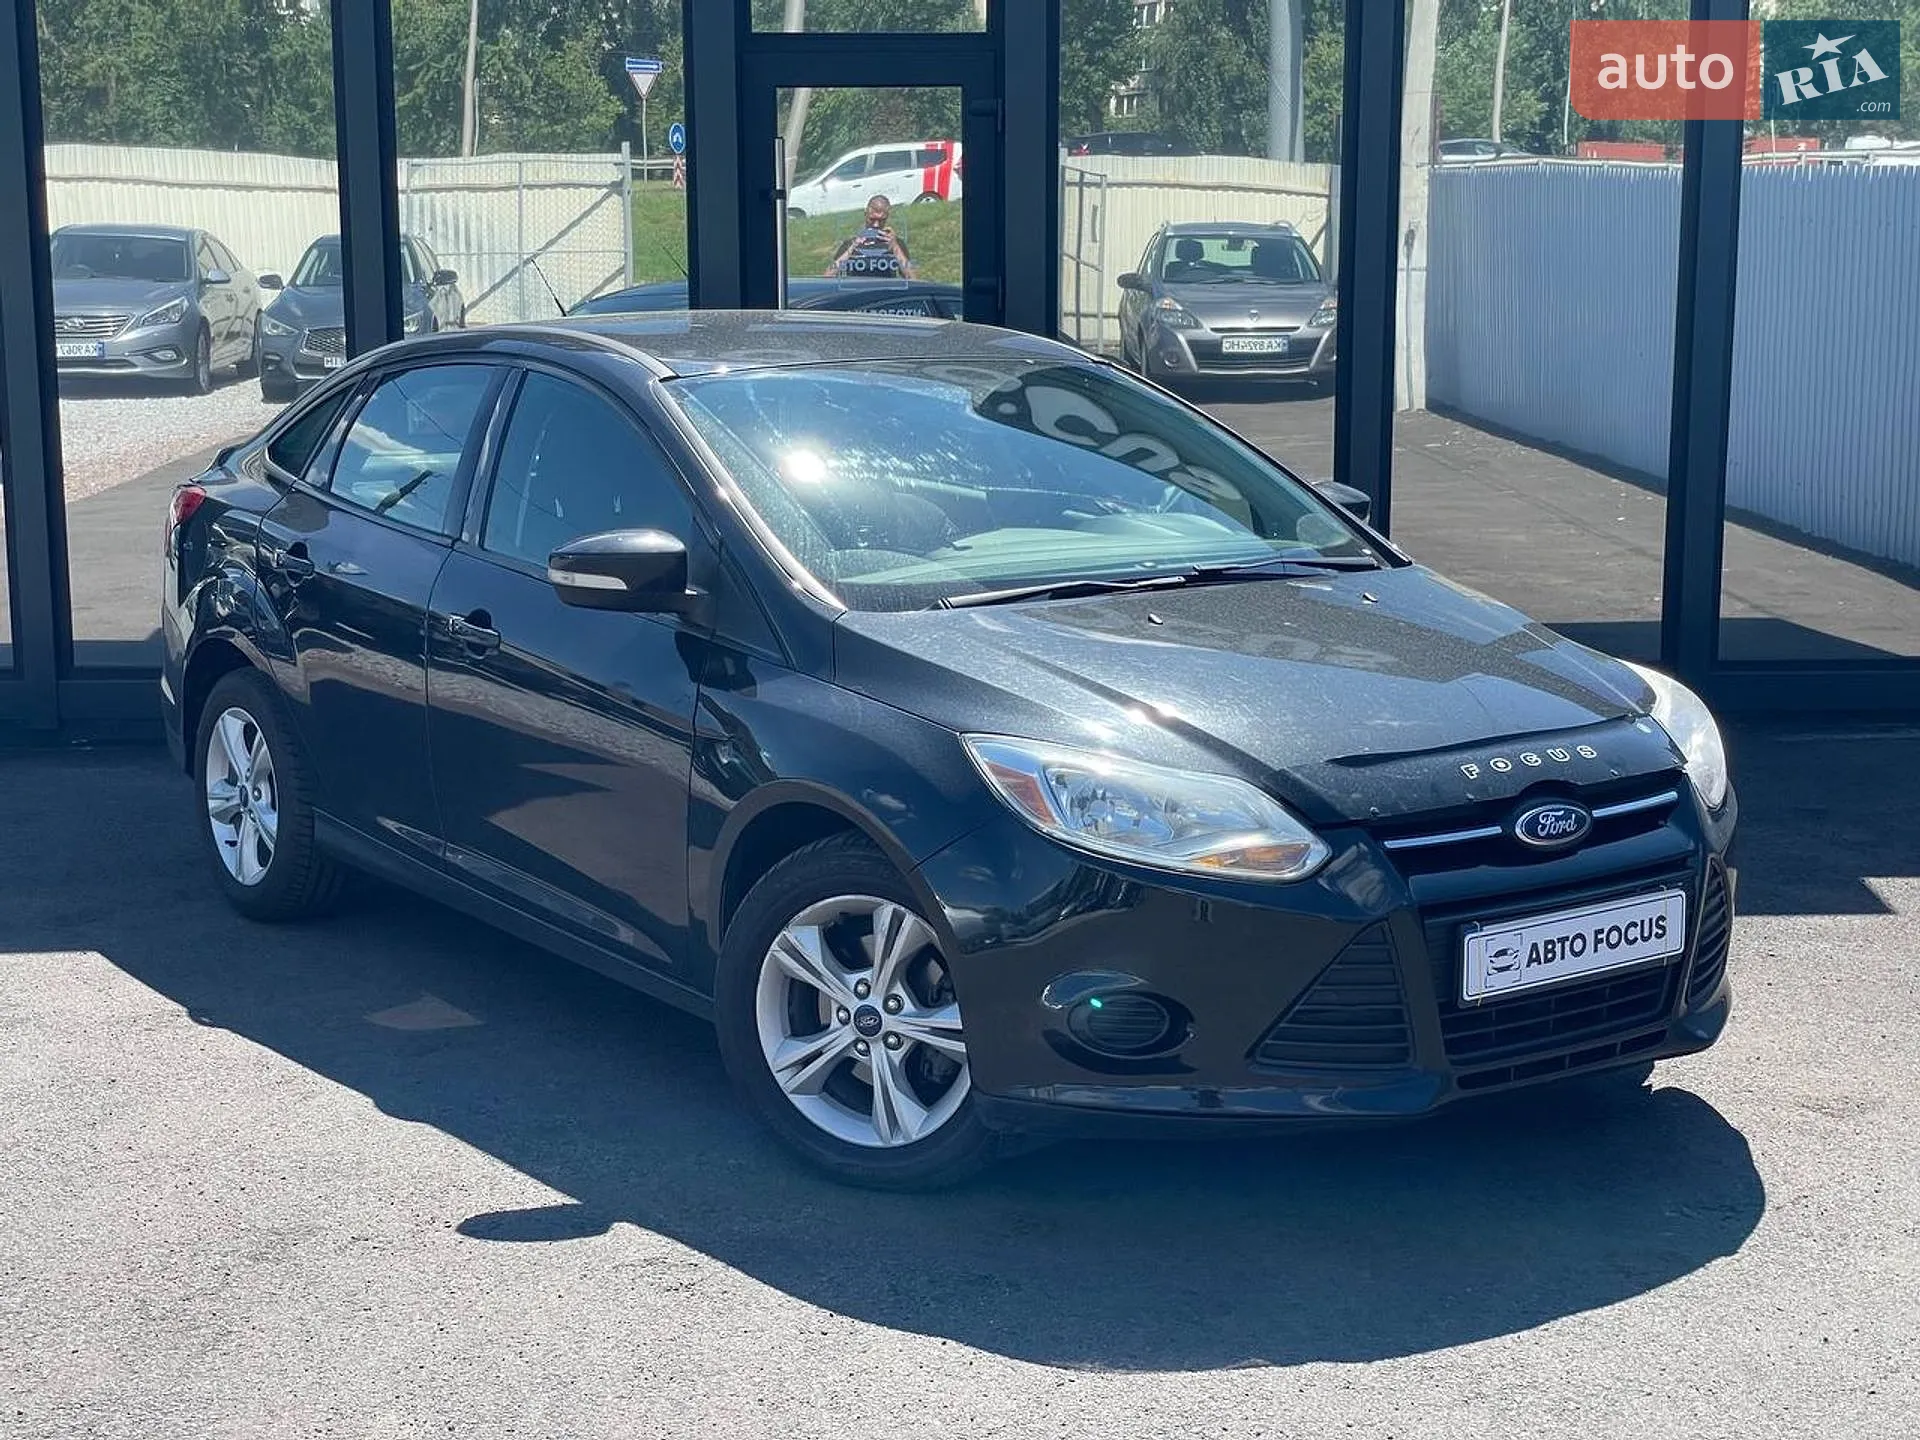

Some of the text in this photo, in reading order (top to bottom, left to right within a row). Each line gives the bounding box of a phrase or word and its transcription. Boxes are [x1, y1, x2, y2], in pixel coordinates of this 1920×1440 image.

[1461, 745, 1597, 779] FOCUS
[1537, 810, 1577, 837] Ford
[1525, 915, 1667, 968] АВТО FOCUS
